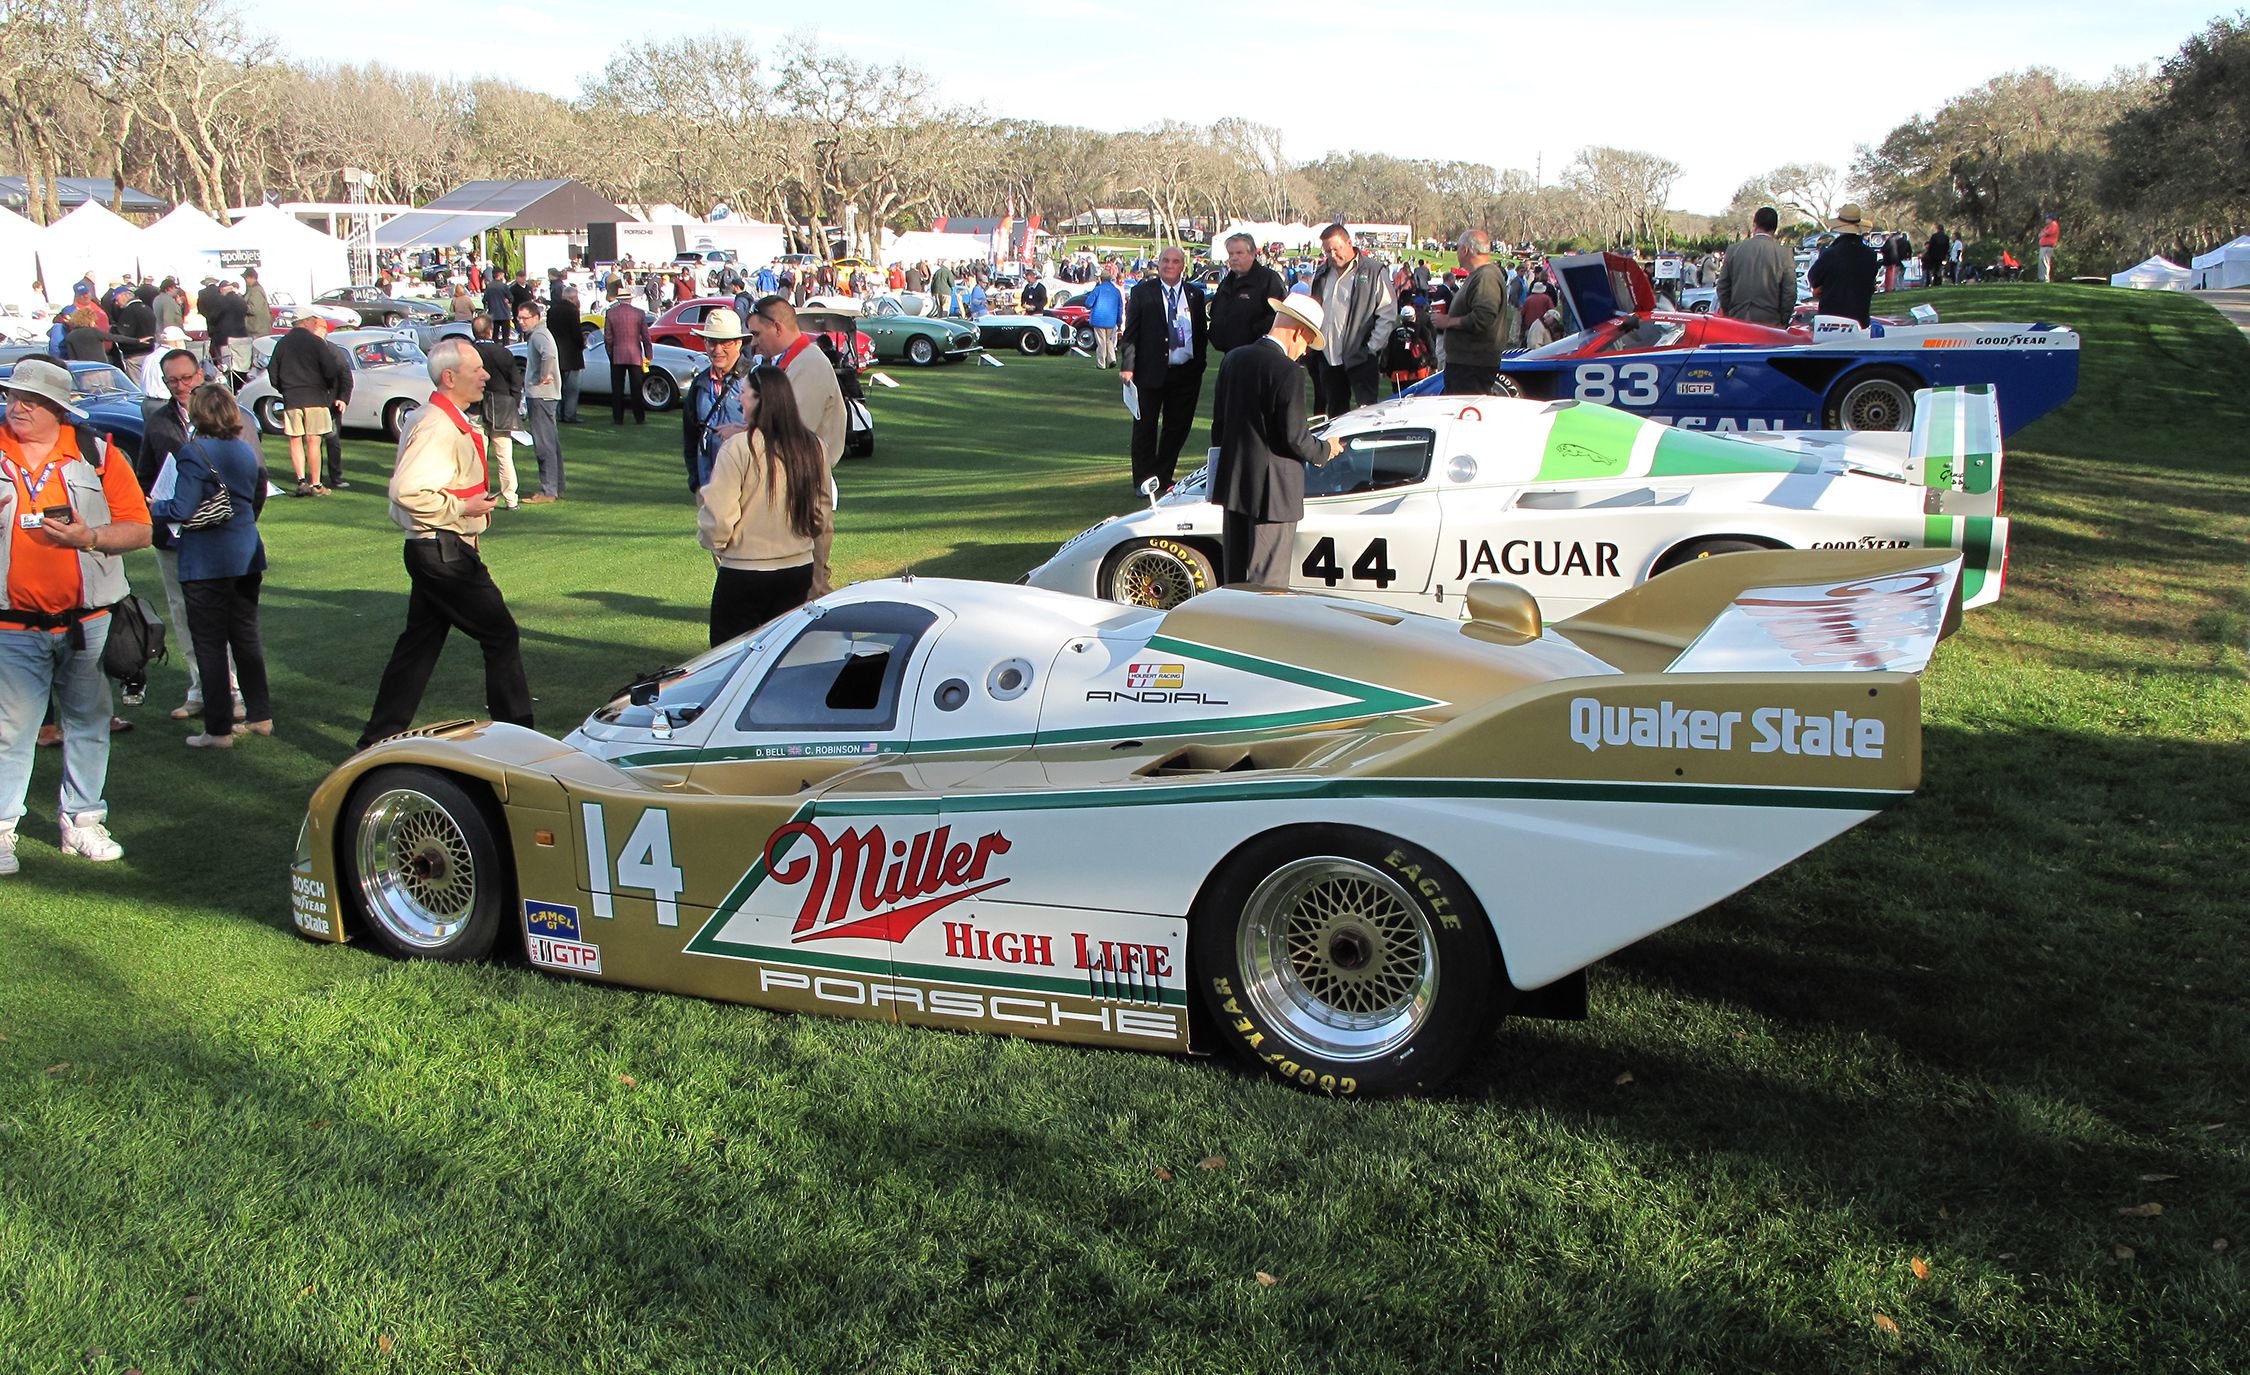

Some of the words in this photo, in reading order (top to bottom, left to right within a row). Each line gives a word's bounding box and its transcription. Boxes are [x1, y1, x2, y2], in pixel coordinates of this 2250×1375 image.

[221, 250, 261, 264] apollojets
[1817, 323, 1853, 333] NPTI
[1575, 363, 1659, 405] 83
[1301, 536, 1397, 588] 44
[1456, 540, 1621, 581] JAGUAR
[1086, 691, 1229, 705] ANDIAL
[1570, 697, 1741, 752] Quaker
[1751, 707, 1884, 759] State
[756, 748, 764, 757] D.
[766, 748, 785, 756] BELL
[805, 746, 813, 755] C.
[816, 745, 860, 754] ROBINSON
[580, 801, 684, 927] 14
[292, 874, 325, 898] BOSCH
[764, 821, 1012, 937] Miller
[1384, 849, 1462, 930] EAGLE
[304, 914, 329, 934] State
[529, 911, 574, 930] CAMEL
[547, 921, 558, 930] GT
[553, 944, 597, 967] GTP
[942, 921, 1055, 967] HIGH
[1071, 932, 1173, 978] LIFE
[759, 967, 1177, 1039] PORSCHE
